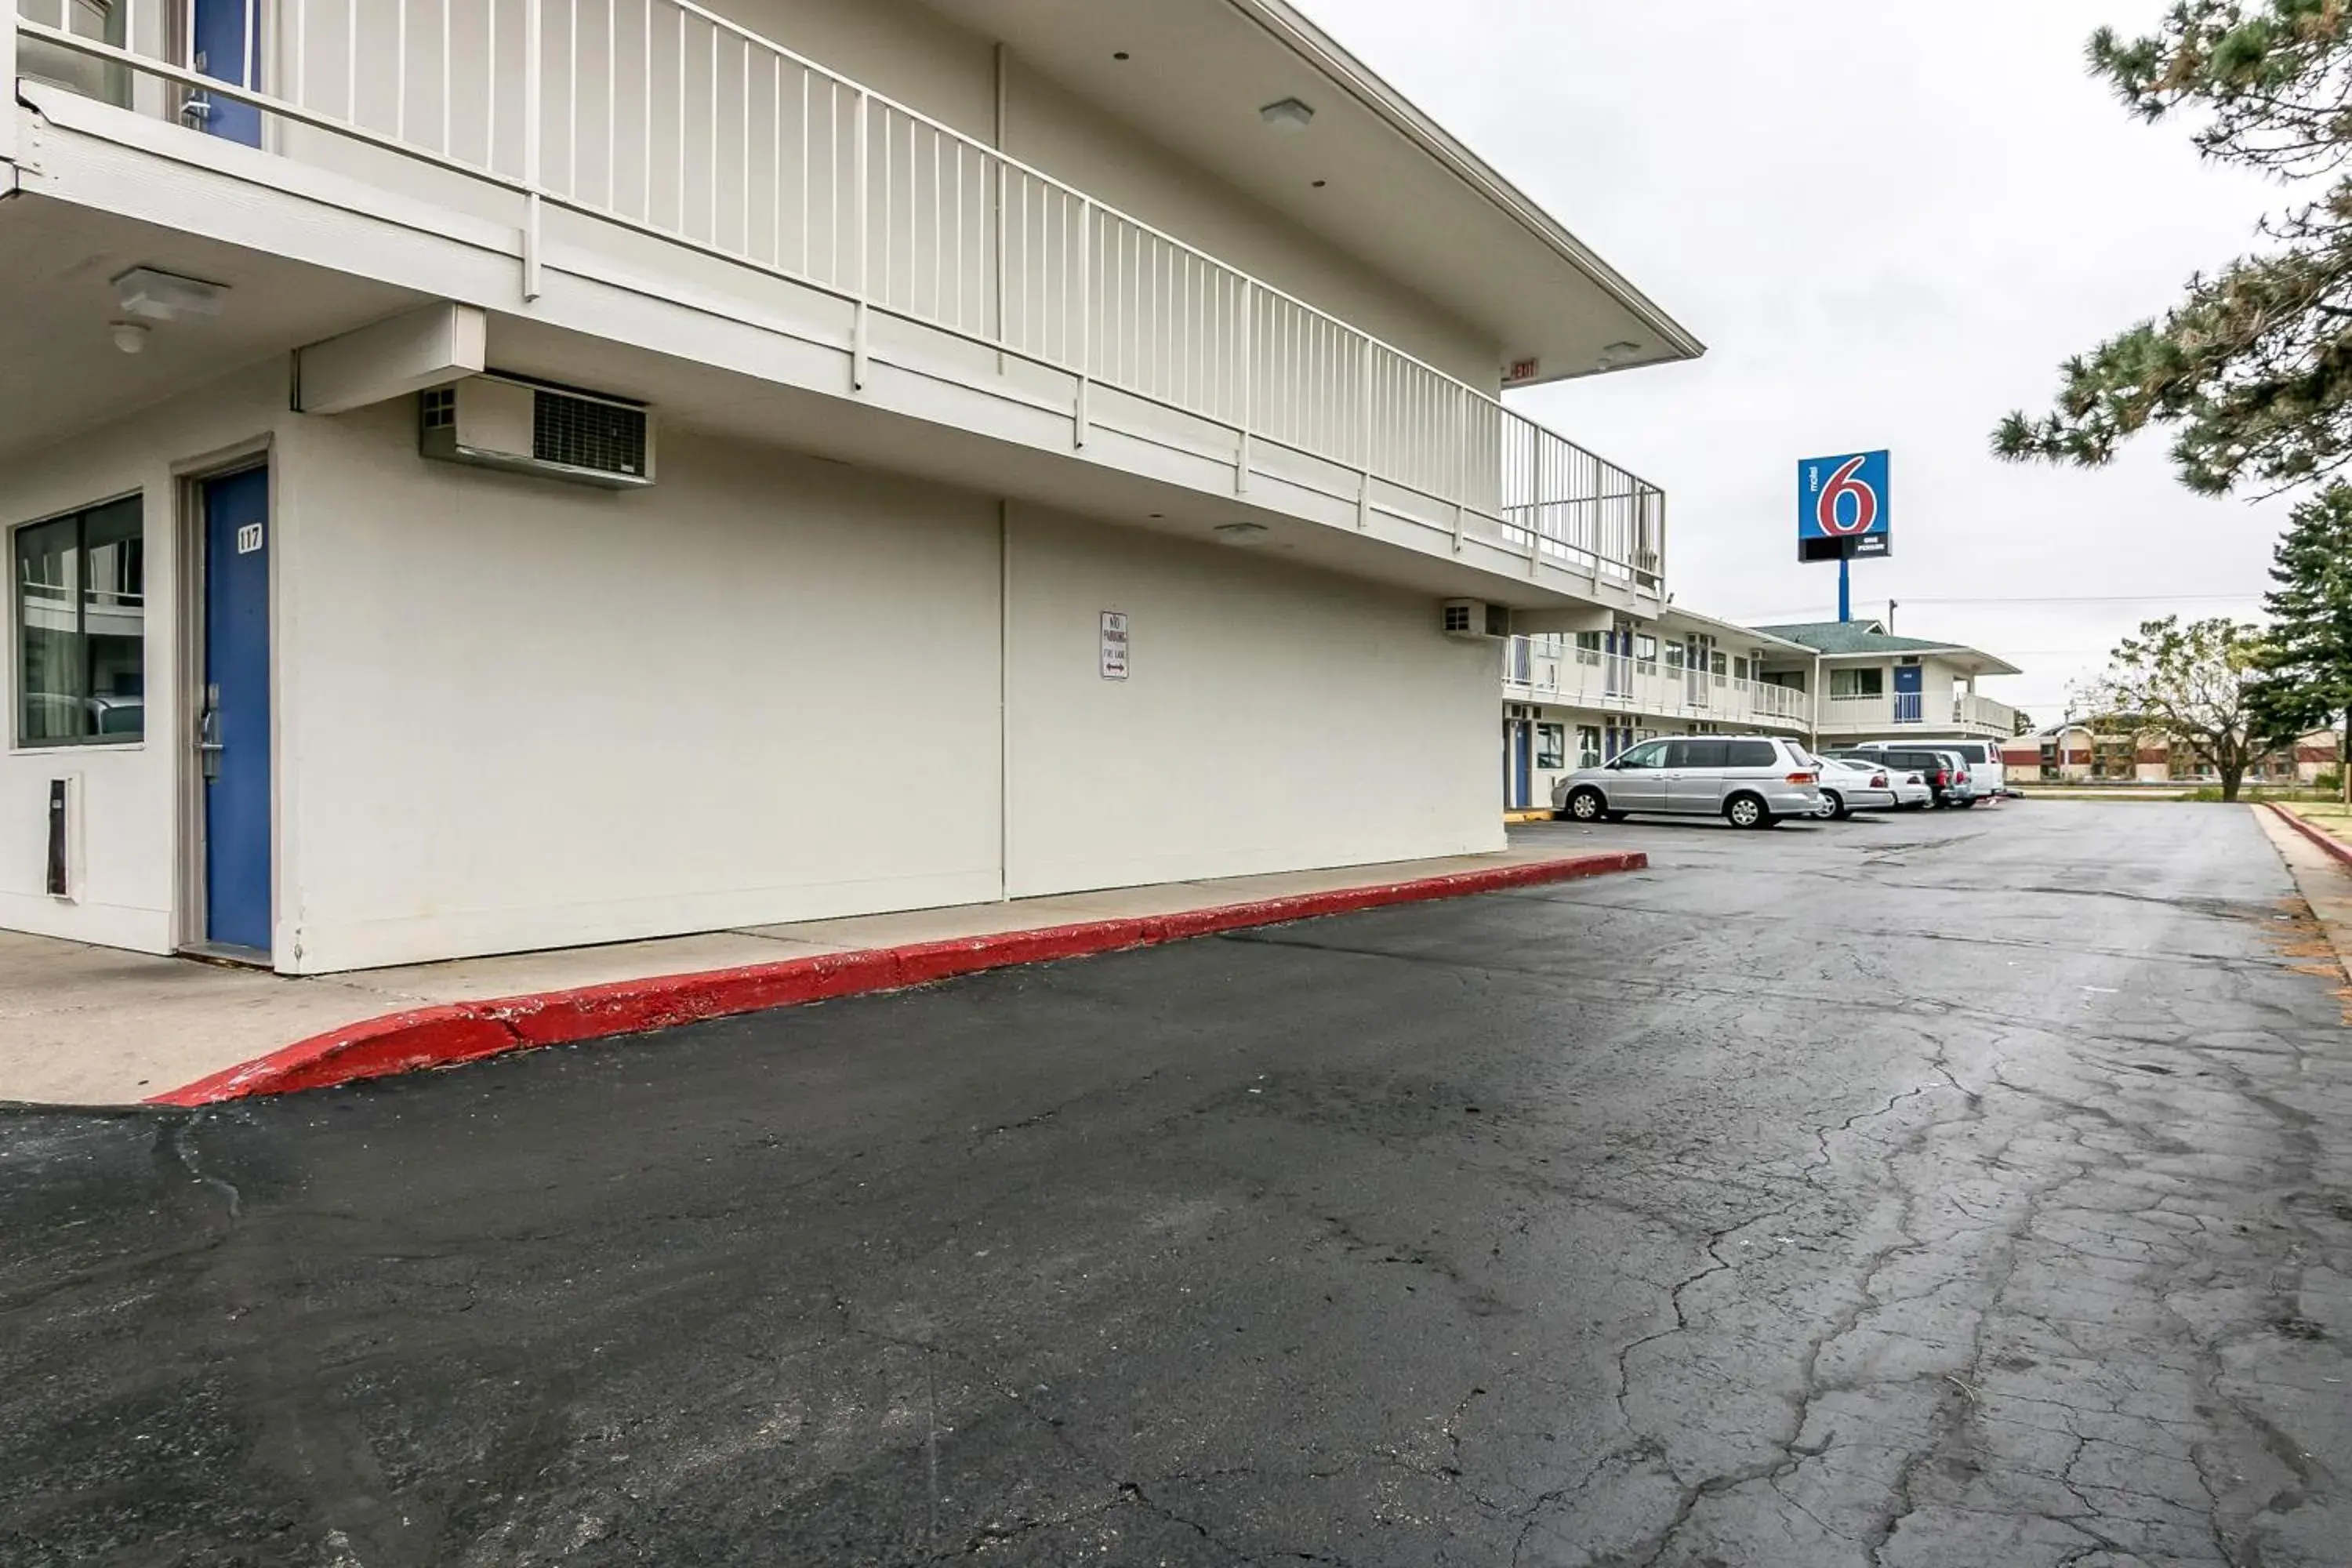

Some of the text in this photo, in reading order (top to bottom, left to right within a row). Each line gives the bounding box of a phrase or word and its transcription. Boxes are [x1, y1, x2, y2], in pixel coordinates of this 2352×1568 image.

[1809, 466, 1818, 492] motel
[1817, 456, 1877, 536] 6
[241, 526, 260, 550] 117
[1109, 615, 1120, 630] NO
